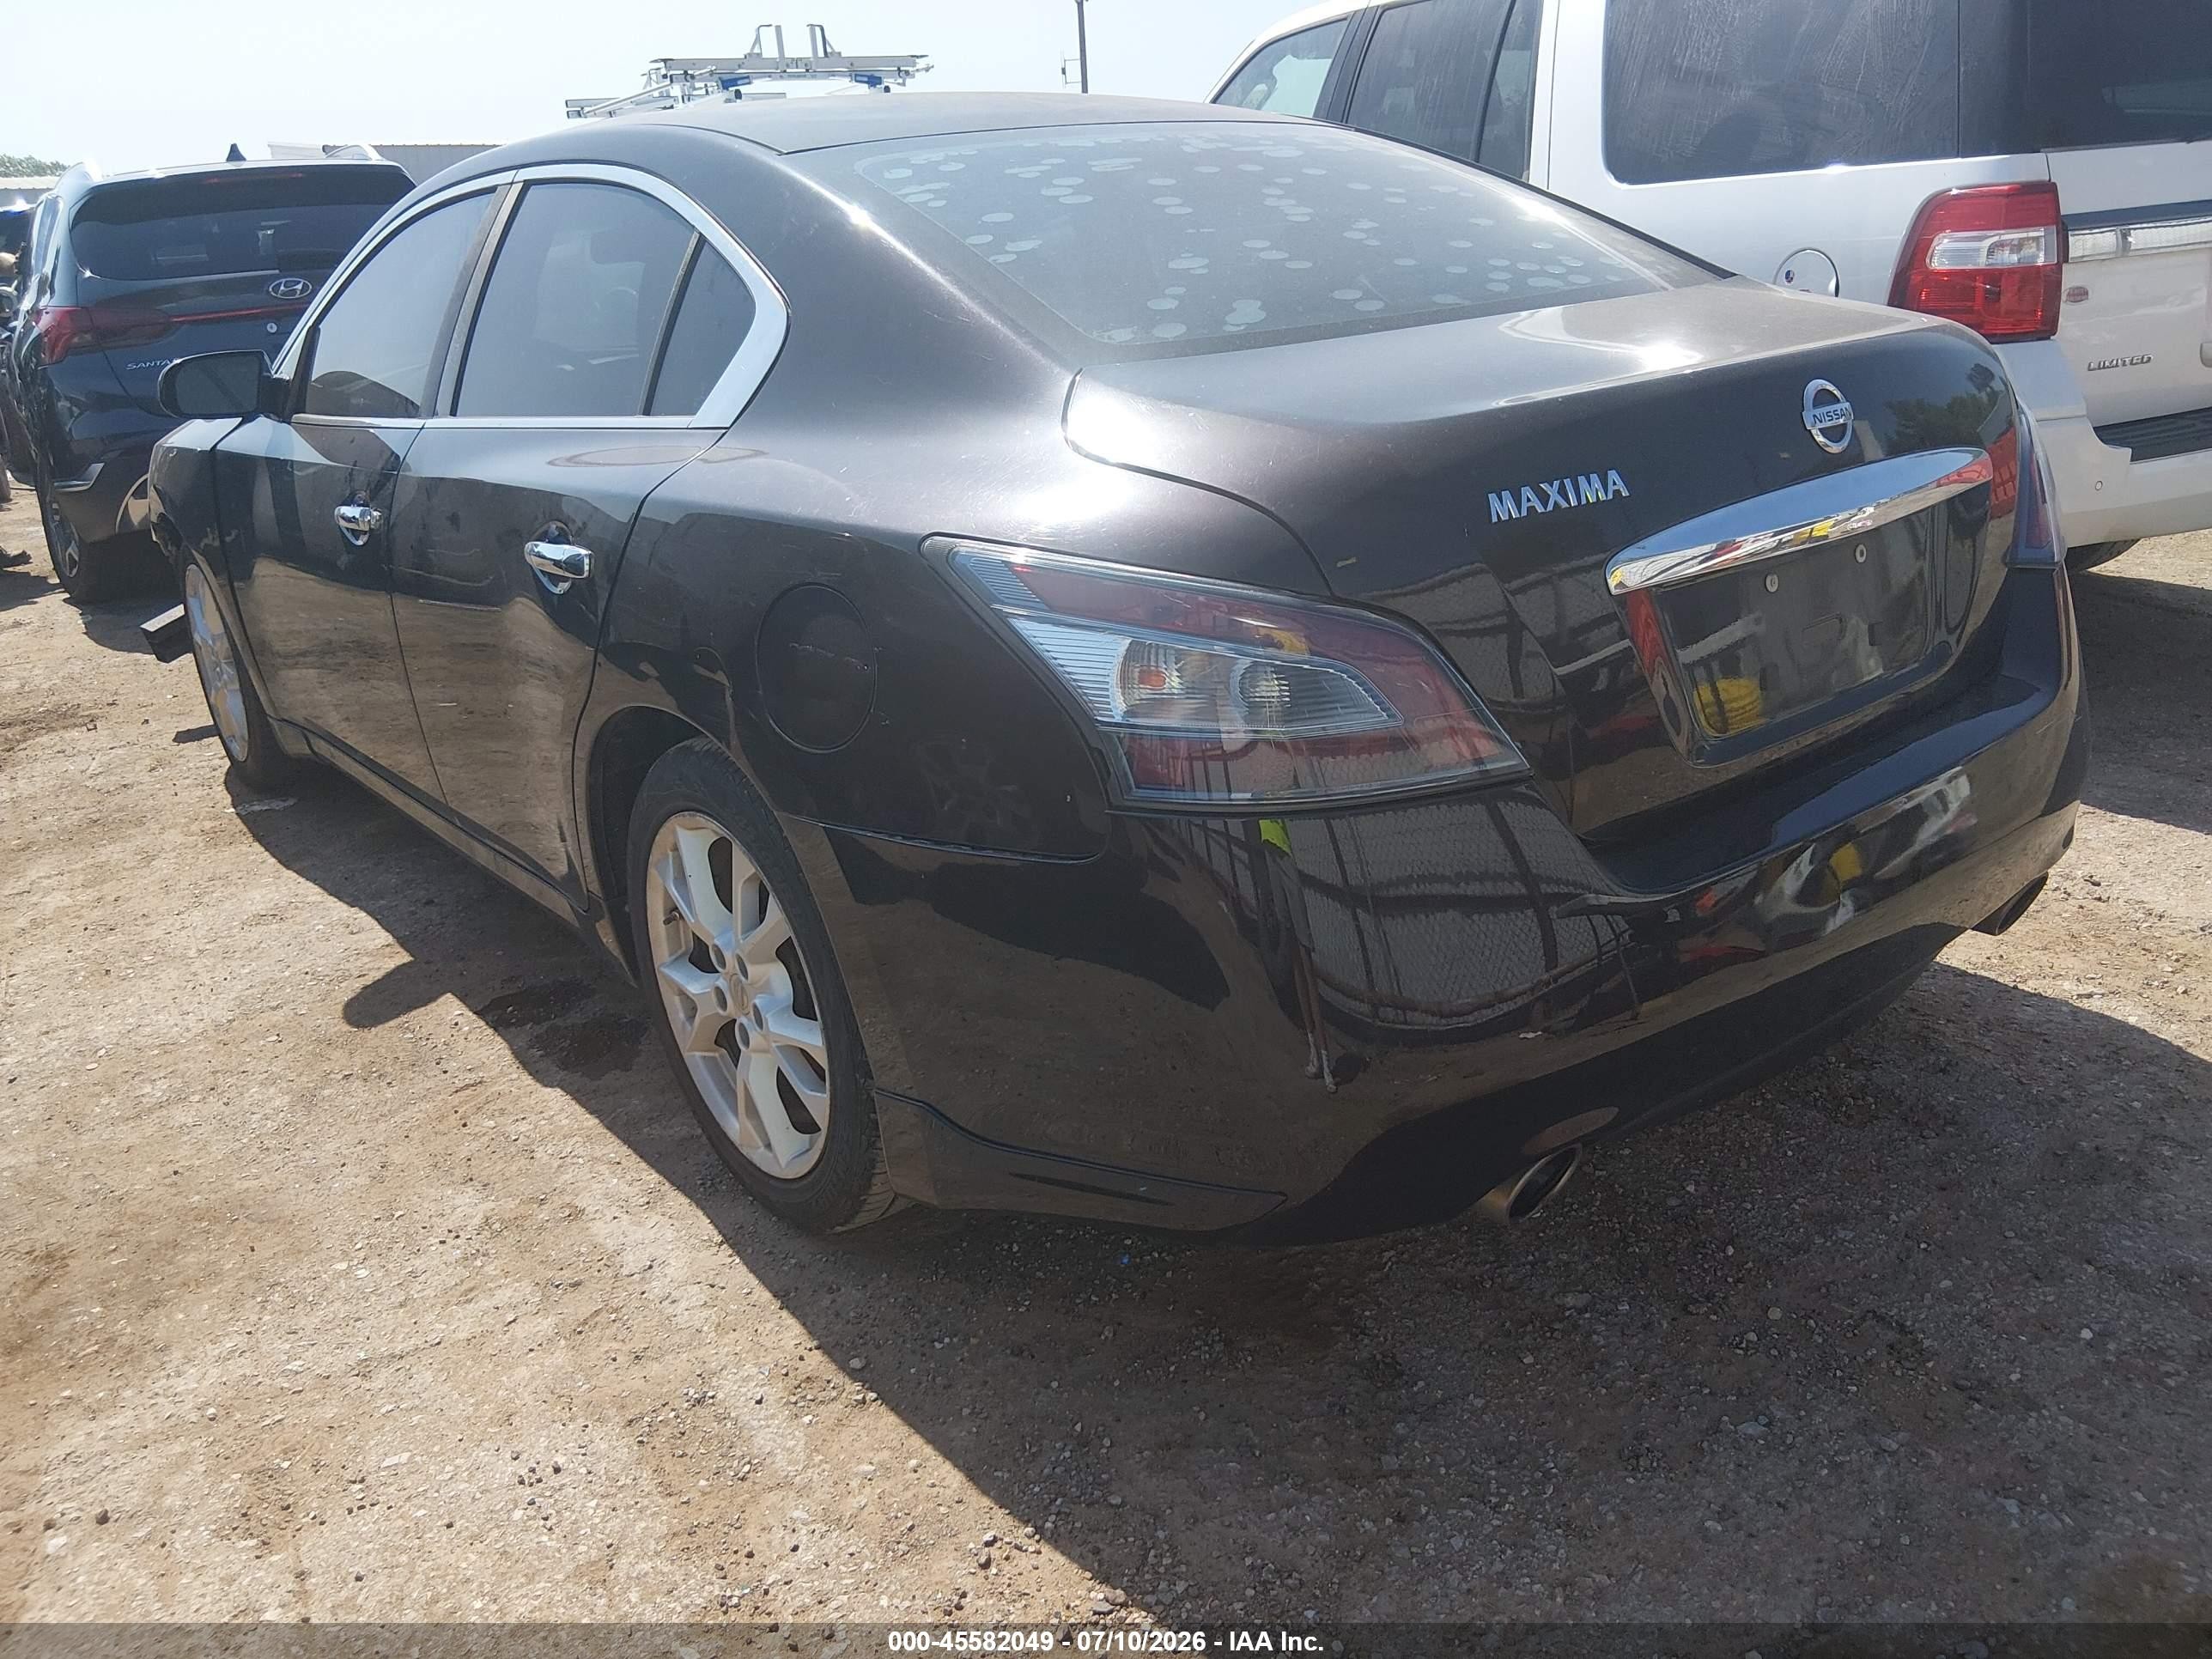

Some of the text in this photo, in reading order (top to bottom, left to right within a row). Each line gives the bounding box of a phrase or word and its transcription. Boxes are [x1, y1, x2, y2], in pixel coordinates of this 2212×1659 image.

[126, 359, 171, 369] SANTA
[2087, 354, 2153, 371] LIMITED
[1813, 406, 1852, 425] NISSAN
[1487, 469, 1630, 523] MAXIMA
